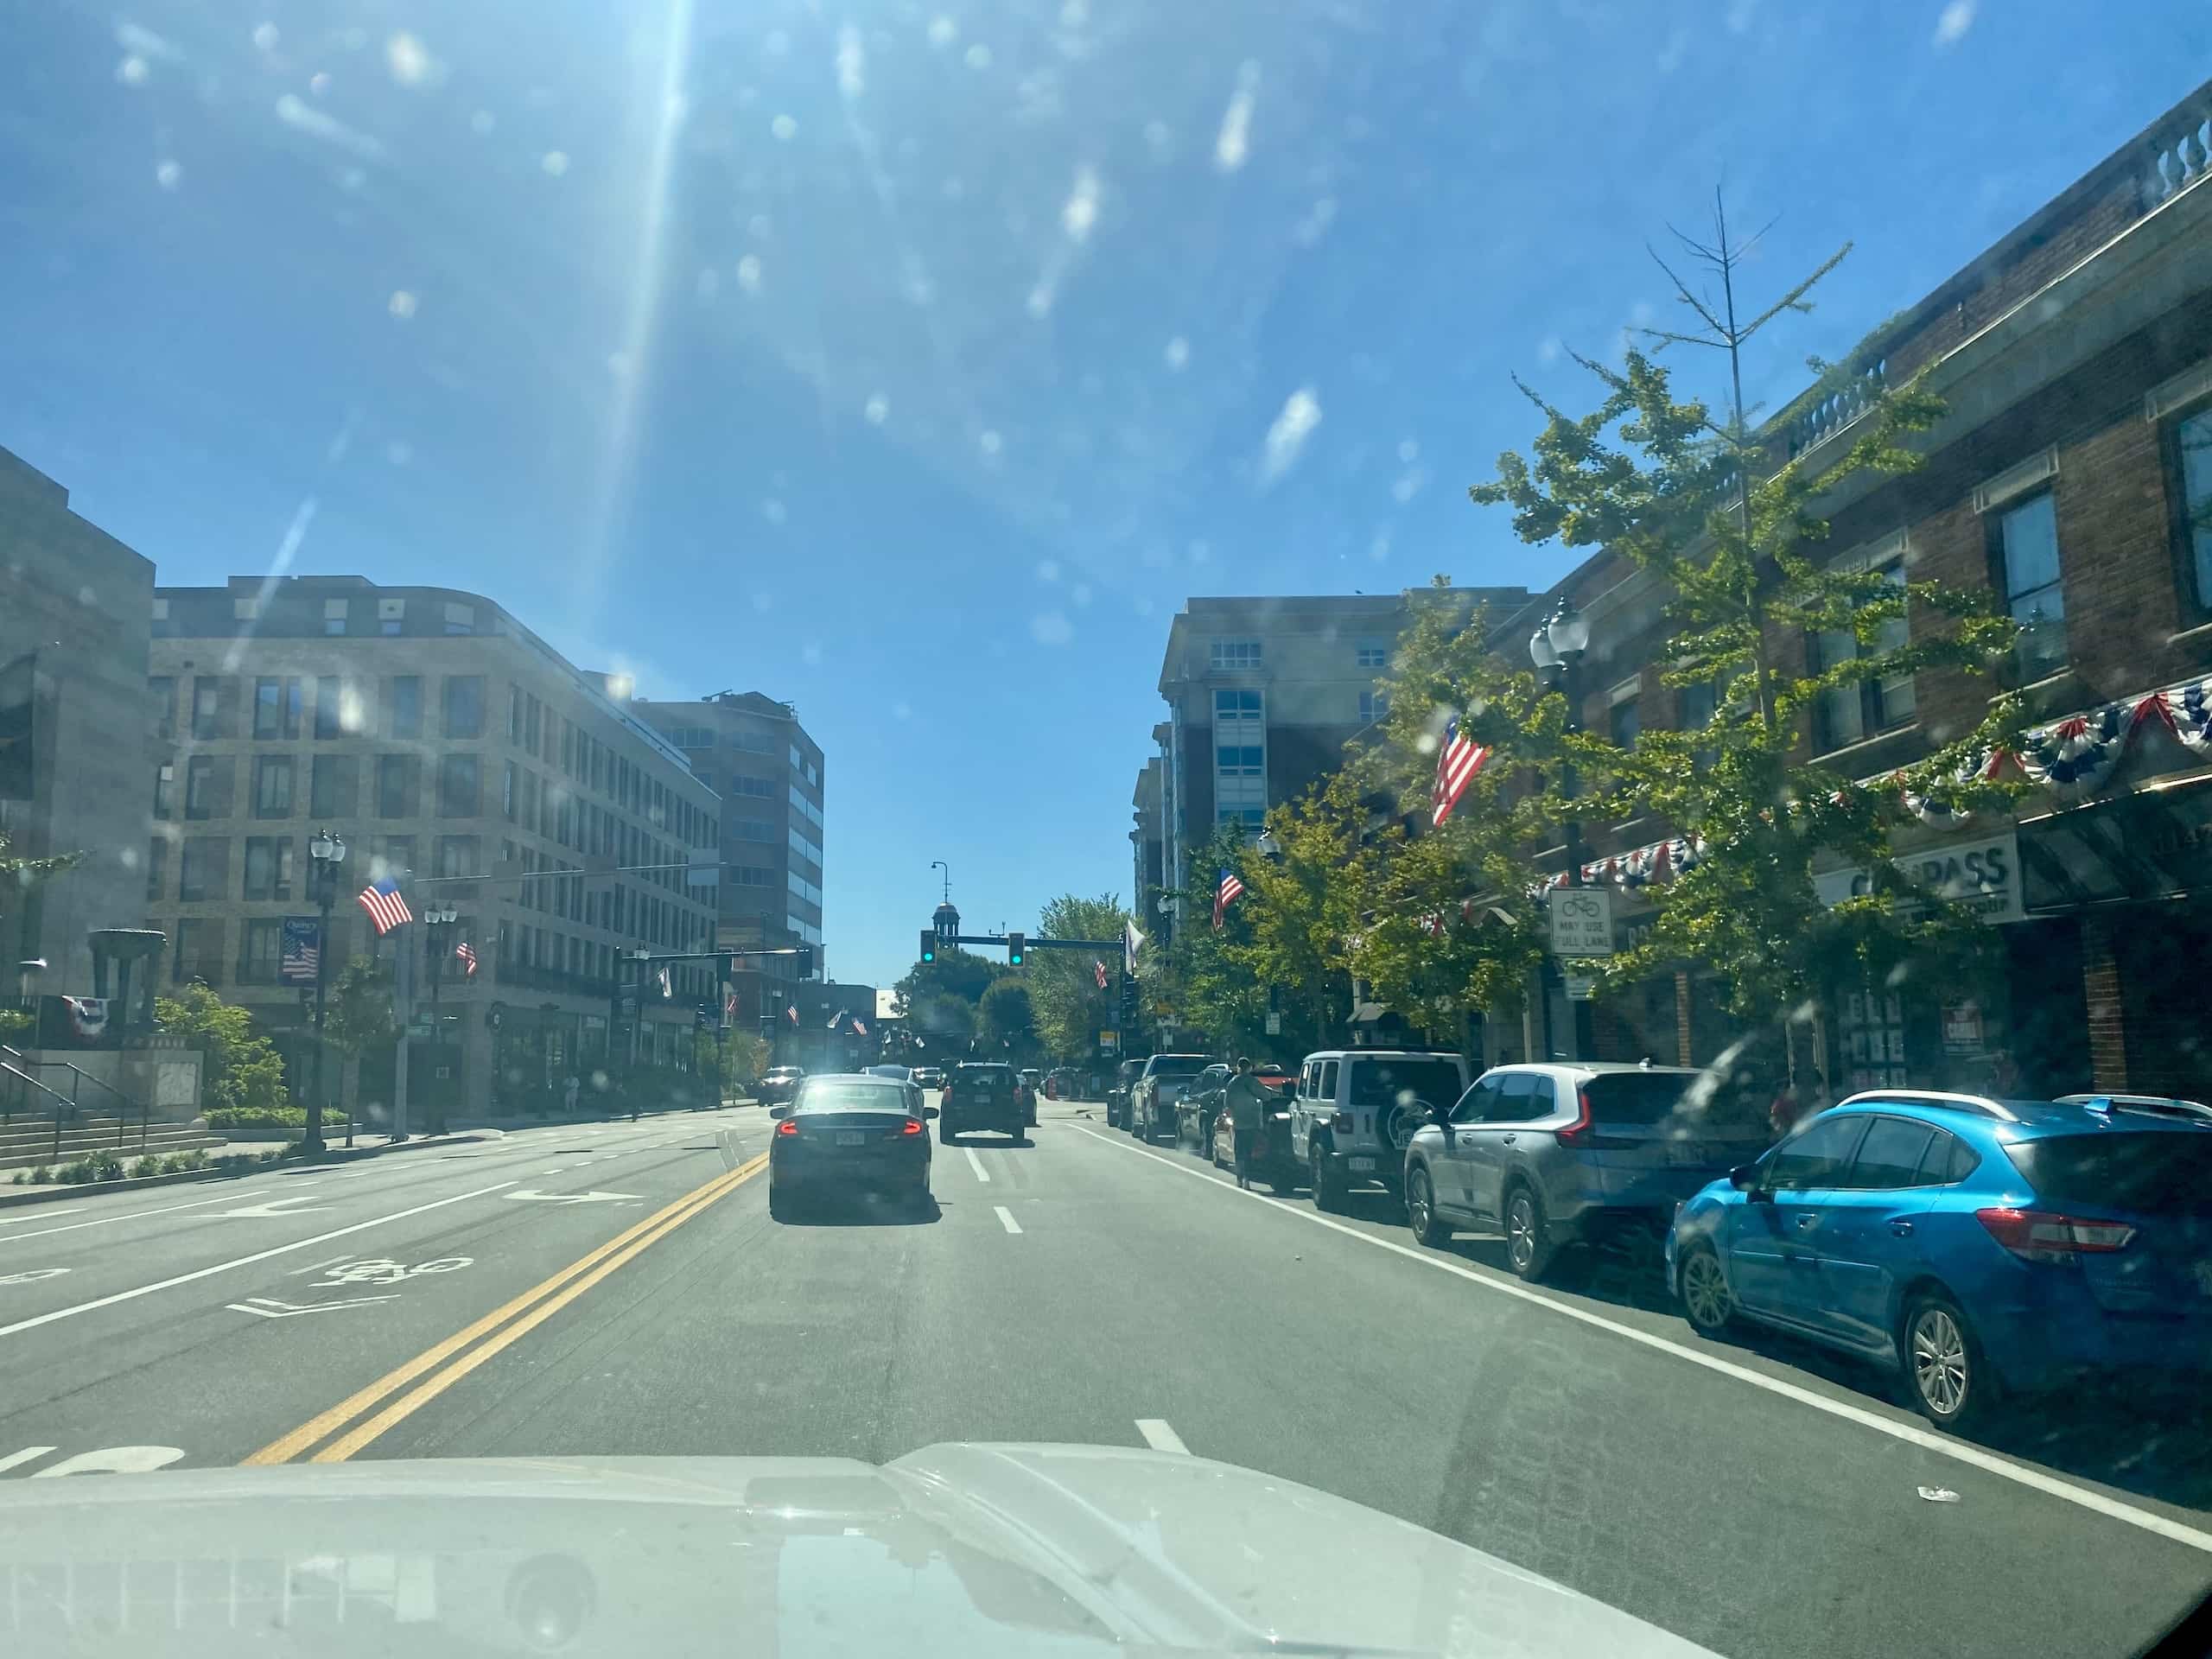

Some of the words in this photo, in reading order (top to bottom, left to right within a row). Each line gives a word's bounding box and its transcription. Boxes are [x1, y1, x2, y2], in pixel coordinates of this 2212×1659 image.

[1851, 847, 2009, 900] CPASS
[1560, 921, 1580, 931] MAY
[1585, 921, 1605, 932] USE
[1586, 936, 1611, 948] LANE
